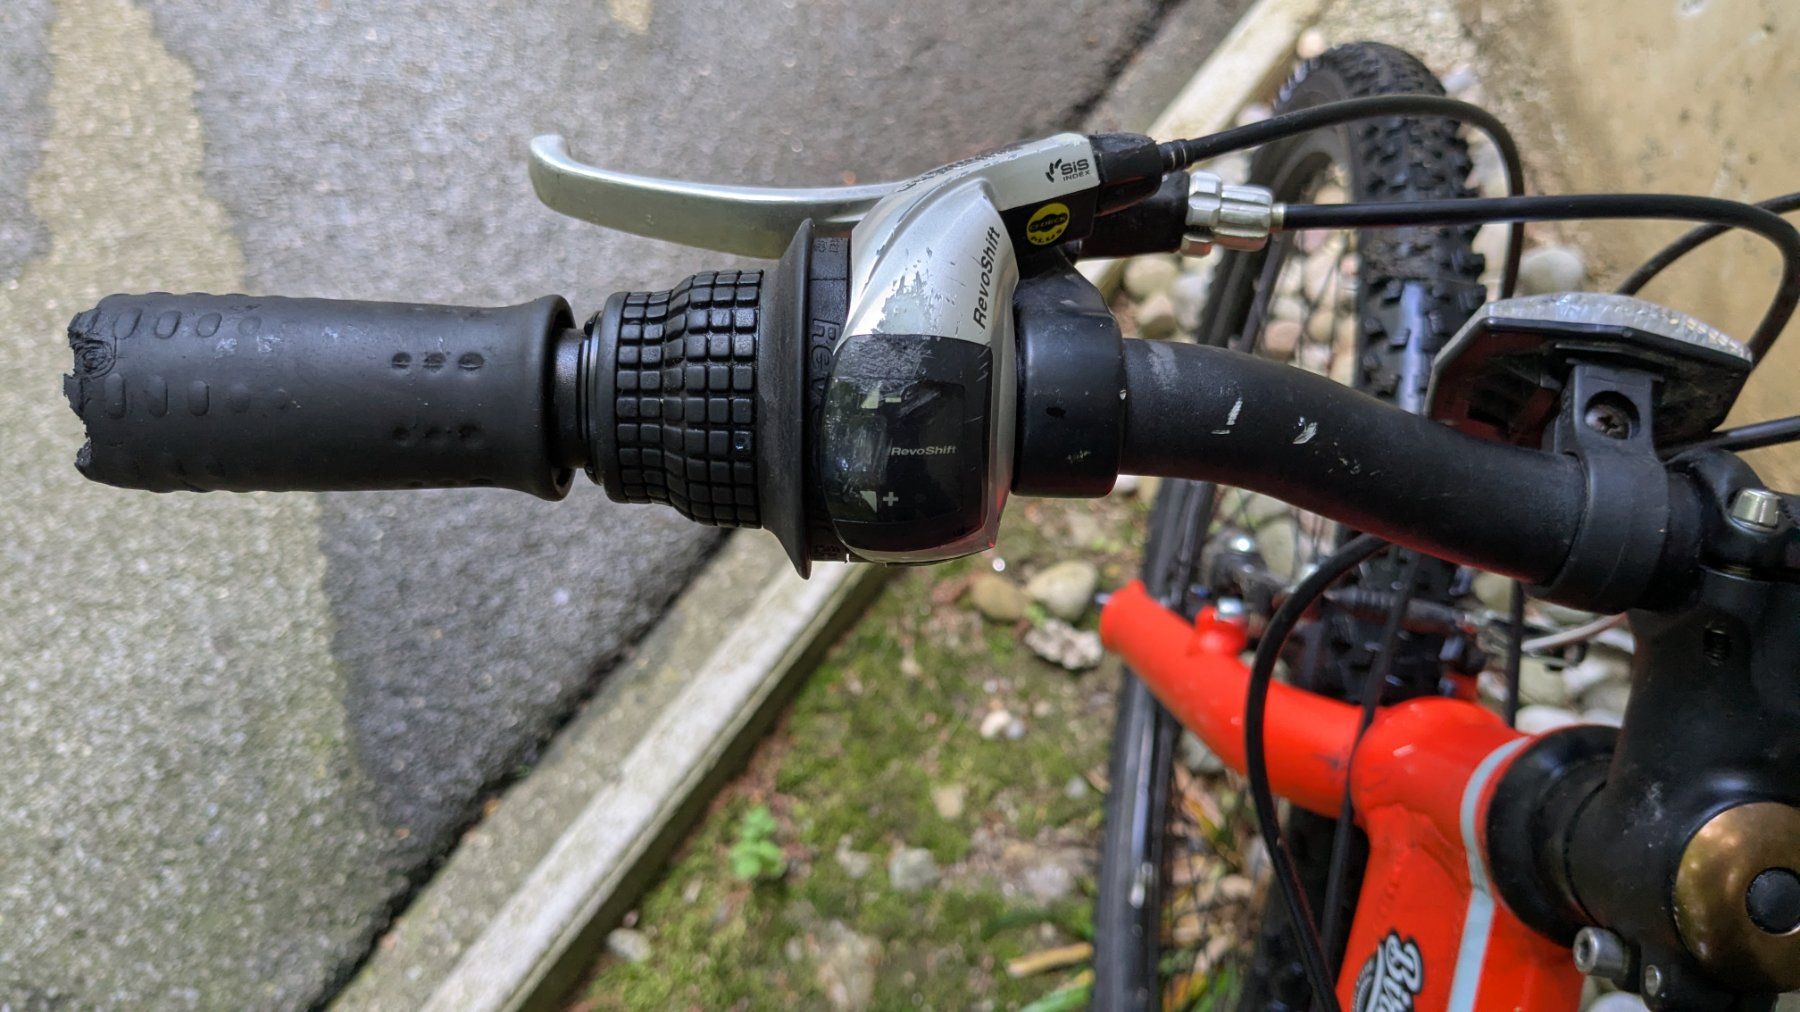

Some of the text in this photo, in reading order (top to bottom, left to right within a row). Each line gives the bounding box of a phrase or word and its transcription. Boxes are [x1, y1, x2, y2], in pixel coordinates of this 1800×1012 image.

[1063, 169, 1091, 182] INDEX
[973, 226, 1001, 330] RevoShift
[890, 445, 957, 457] RevoShift
